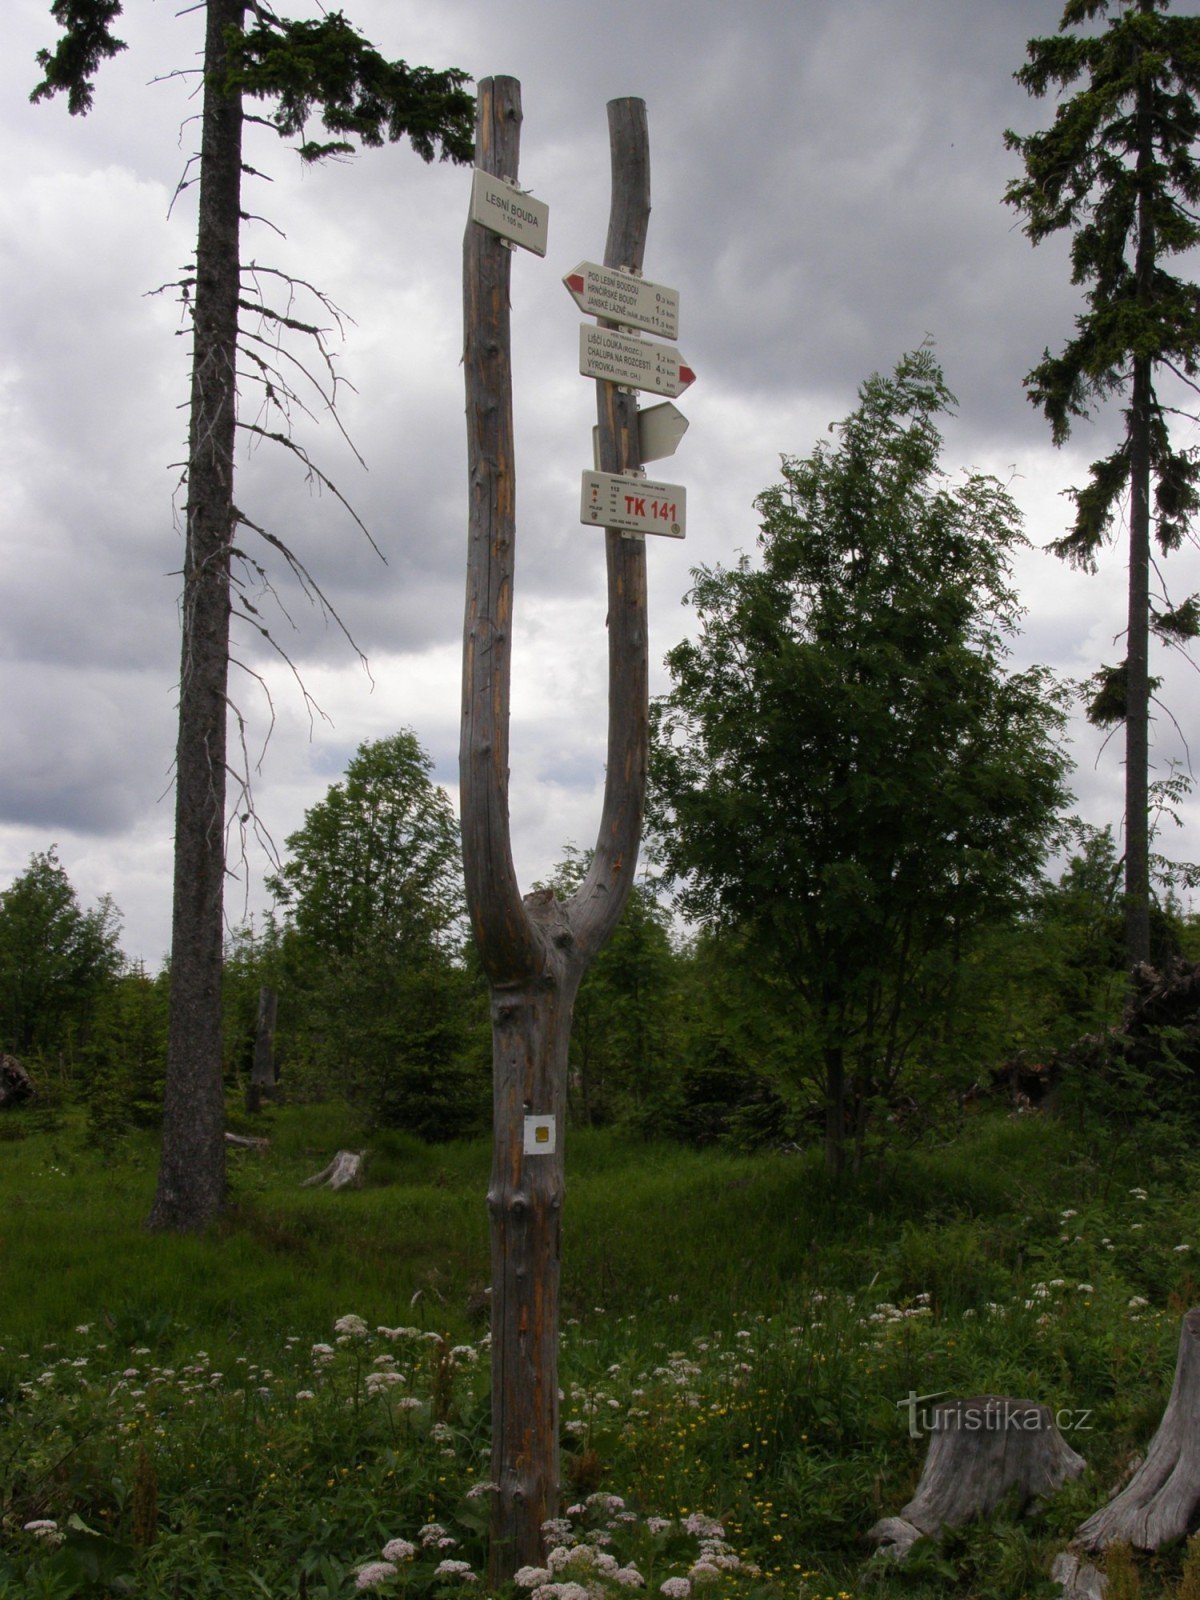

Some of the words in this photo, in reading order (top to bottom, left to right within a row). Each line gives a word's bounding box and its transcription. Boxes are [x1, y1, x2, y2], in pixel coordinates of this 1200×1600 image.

[486, 192, 510, 211] LESNÍ
[511, 204, 538, 227] BOUDA
[588, 271, 599, 282] POD
[600, 274, 614, 288] LESNÍ
[616, 280, 639, 294] BOUDOU
[666, 297, 675, 306] km
[588, 296, 608, 309] JANSKÉ
[609, 301, 626, 316] LÁZNĚ
[666, 322, 675, 330] km
[619, 293, 637, 306] BOUDY
[666, 309, 675, 318] km
[588, 332, 602, 345] LIŠČÍ
[603, 338, 622, 350] LOUKA
[667, 356, 675, 364] km
[588, 346, 615, 360] CHALUPA
[615, 353, 623, 363] NA
[667, 368, 675, 376] km
[587, 359, 614, 374] VÝROVKA
[656, 377, 661, 386] 6
[667, 380, 675, 388] km
[624, 495, 646, 517] TK
[651, 500, 677, 522] 141
